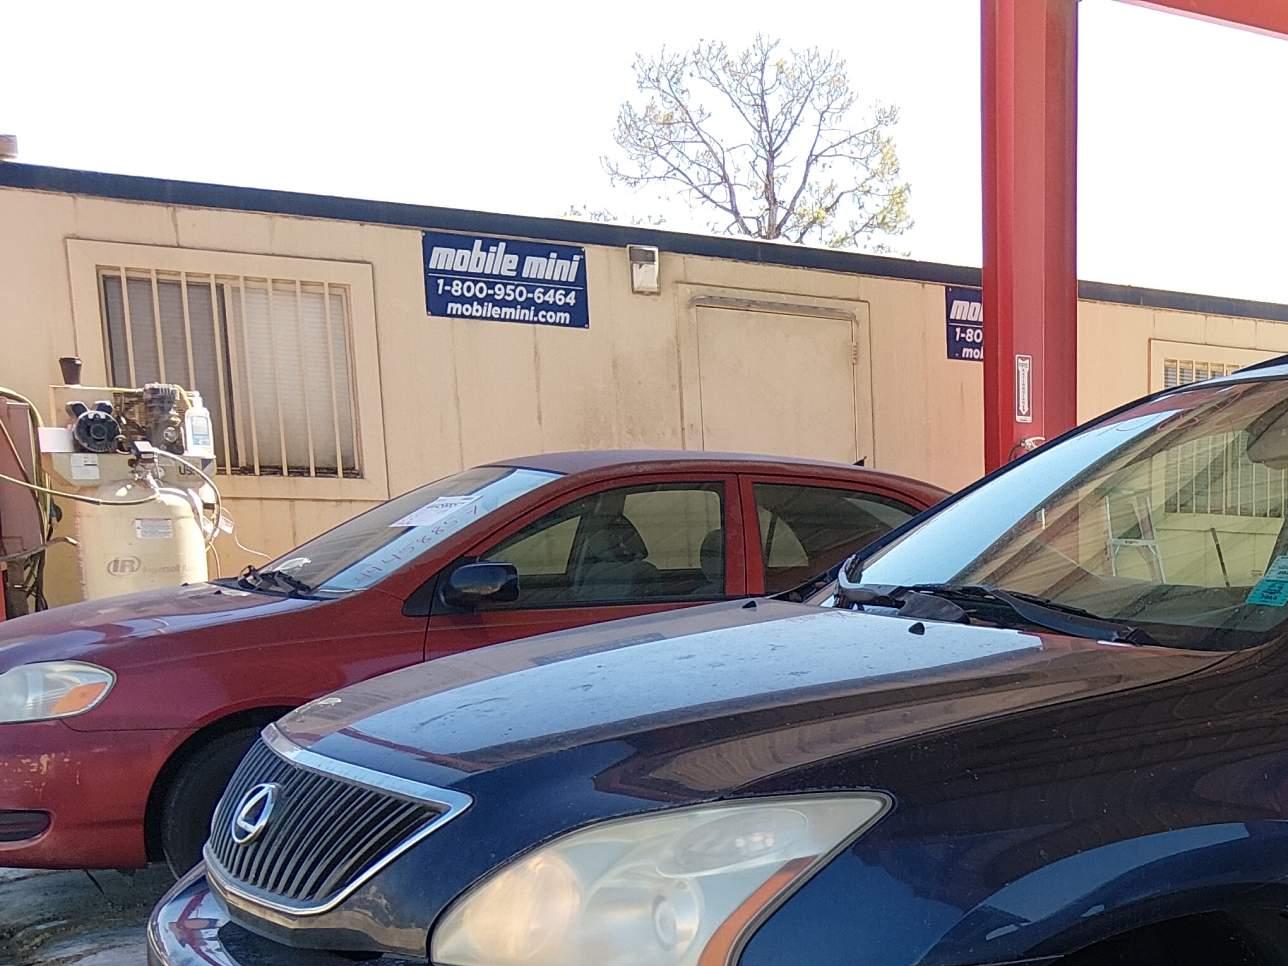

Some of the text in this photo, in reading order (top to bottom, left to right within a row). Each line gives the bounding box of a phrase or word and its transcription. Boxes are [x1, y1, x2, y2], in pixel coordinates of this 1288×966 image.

[429, 240, 581, 282] mobile mini
[437, 279, 576, 306] 1-800-950-6464
[447, 302, 570, 324] mobilemini.com
